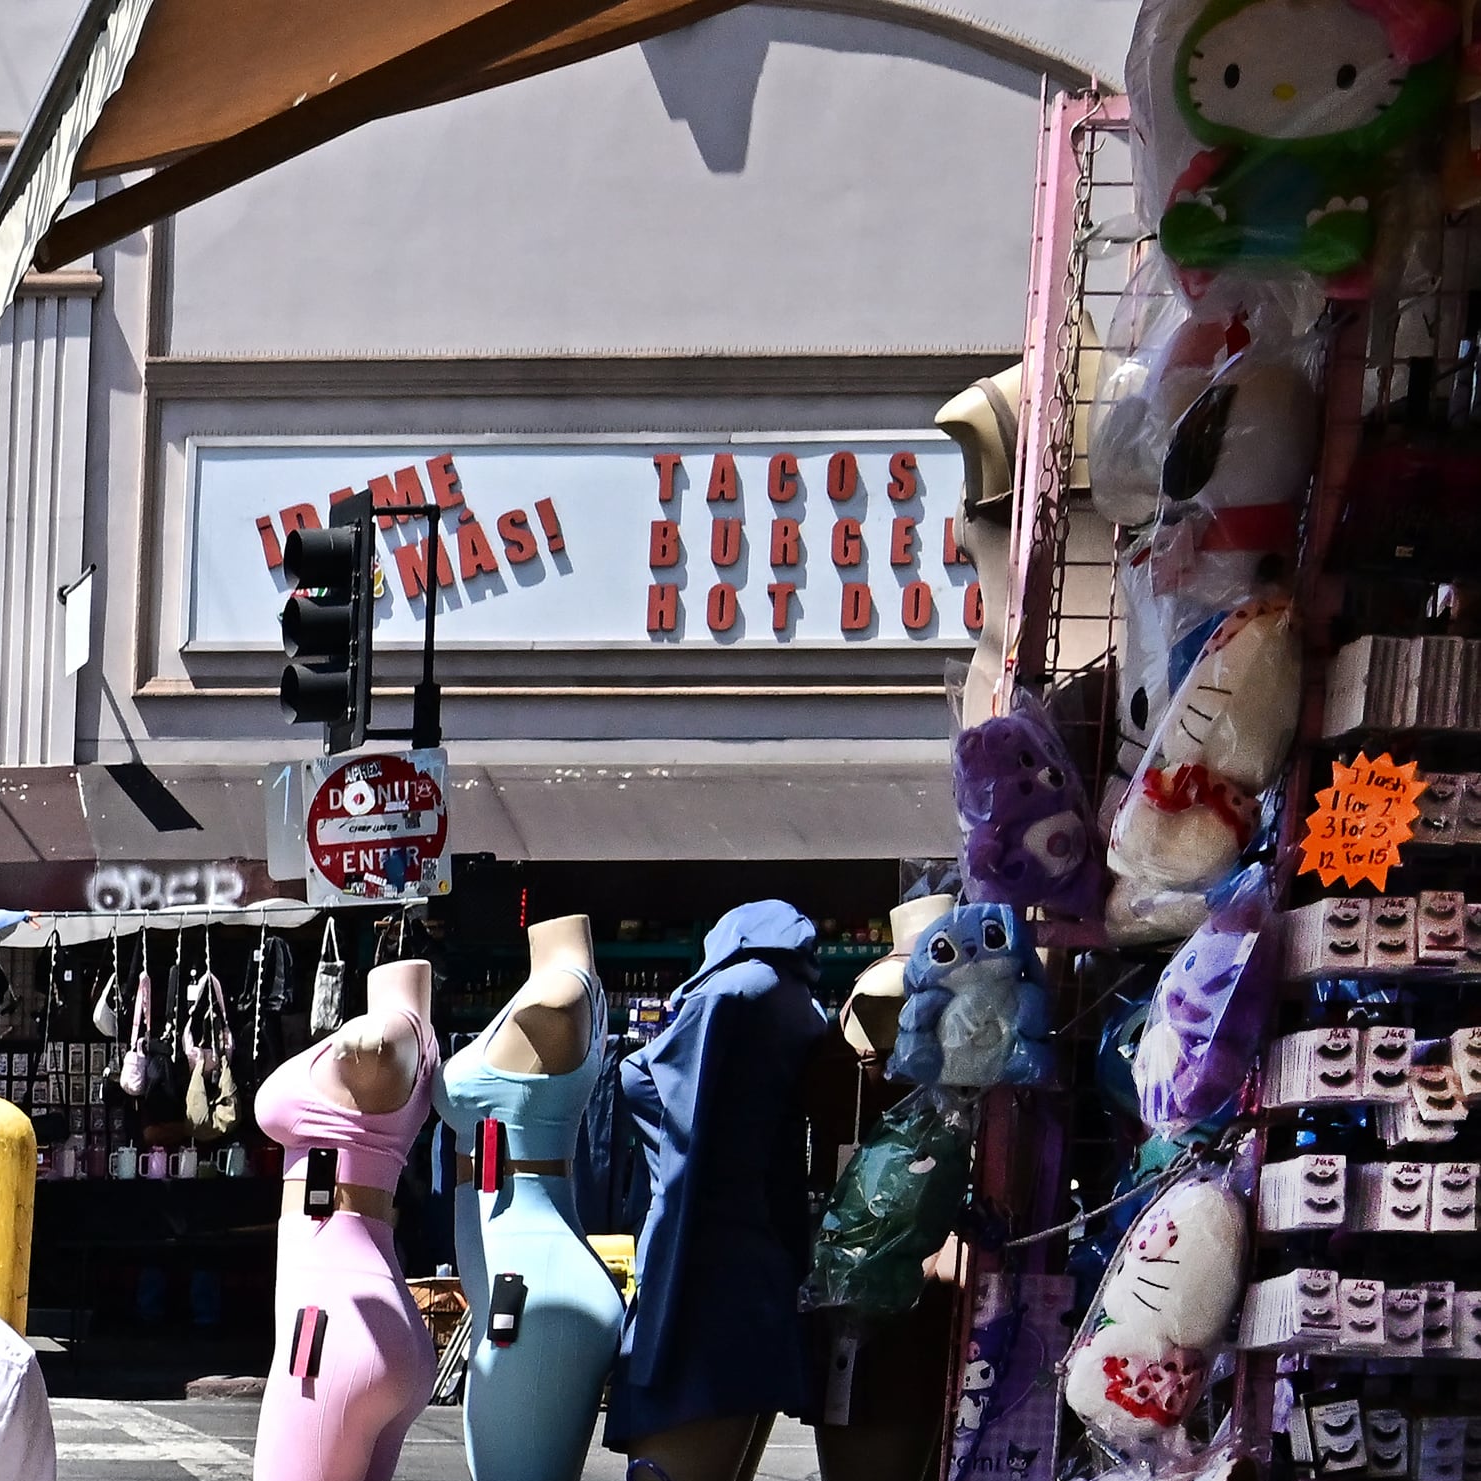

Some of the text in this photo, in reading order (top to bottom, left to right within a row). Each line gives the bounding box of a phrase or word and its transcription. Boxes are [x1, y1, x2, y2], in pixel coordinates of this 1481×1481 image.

[652, 451, 917, 501] TACOS
[255, 452, 465, 569] ¡DME
[393, 496, 567, 600] MÁS!
[647, 581, 795, 632] HOT
[1320, 815, 1336, 839] 3
[1318, 850, 1337, 870] 12
